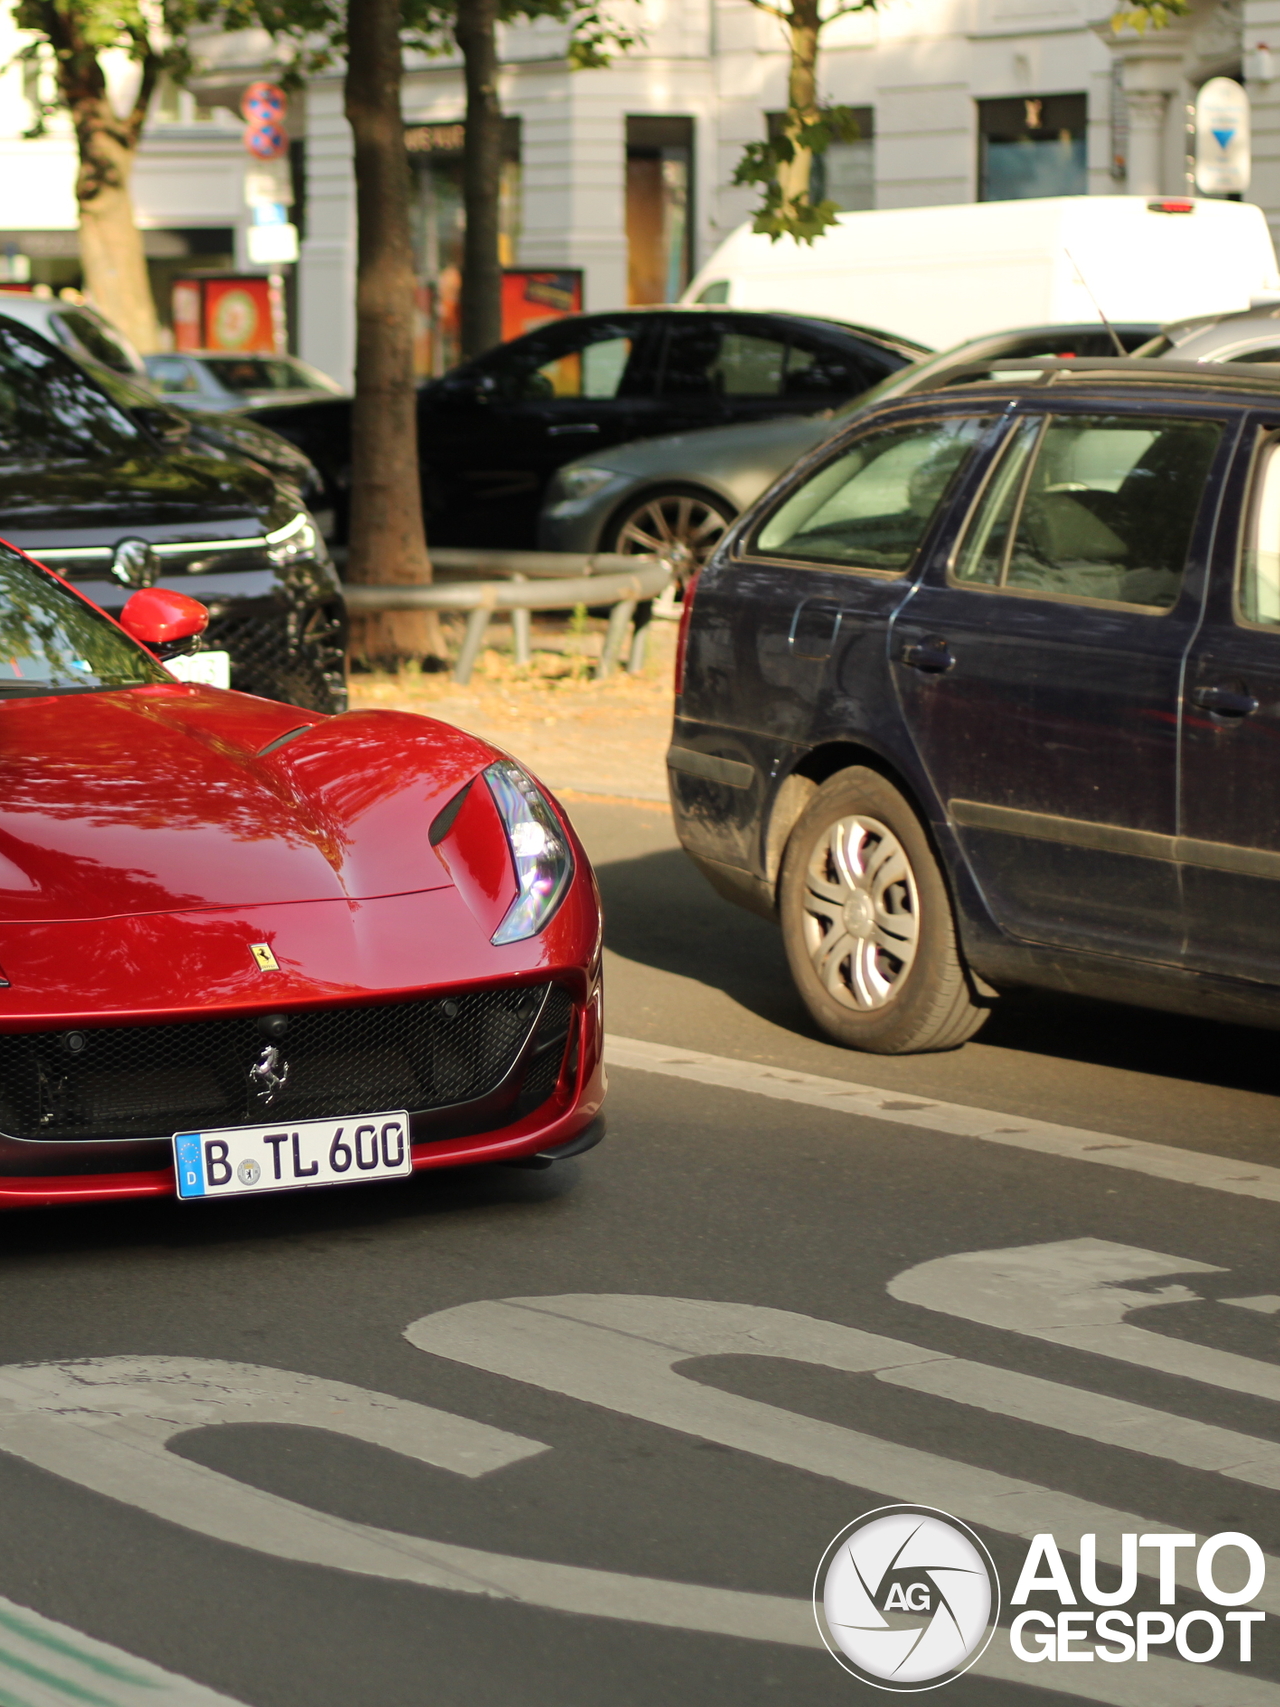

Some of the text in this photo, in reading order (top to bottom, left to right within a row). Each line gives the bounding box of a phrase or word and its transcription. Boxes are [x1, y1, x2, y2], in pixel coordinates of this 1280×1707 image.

[204, 1139, 233, 1187] B
[262, 1132, 319, 1180] TL
[328, 1121, 405, 1173] 600
[186, 1171, 197, 1186] D
